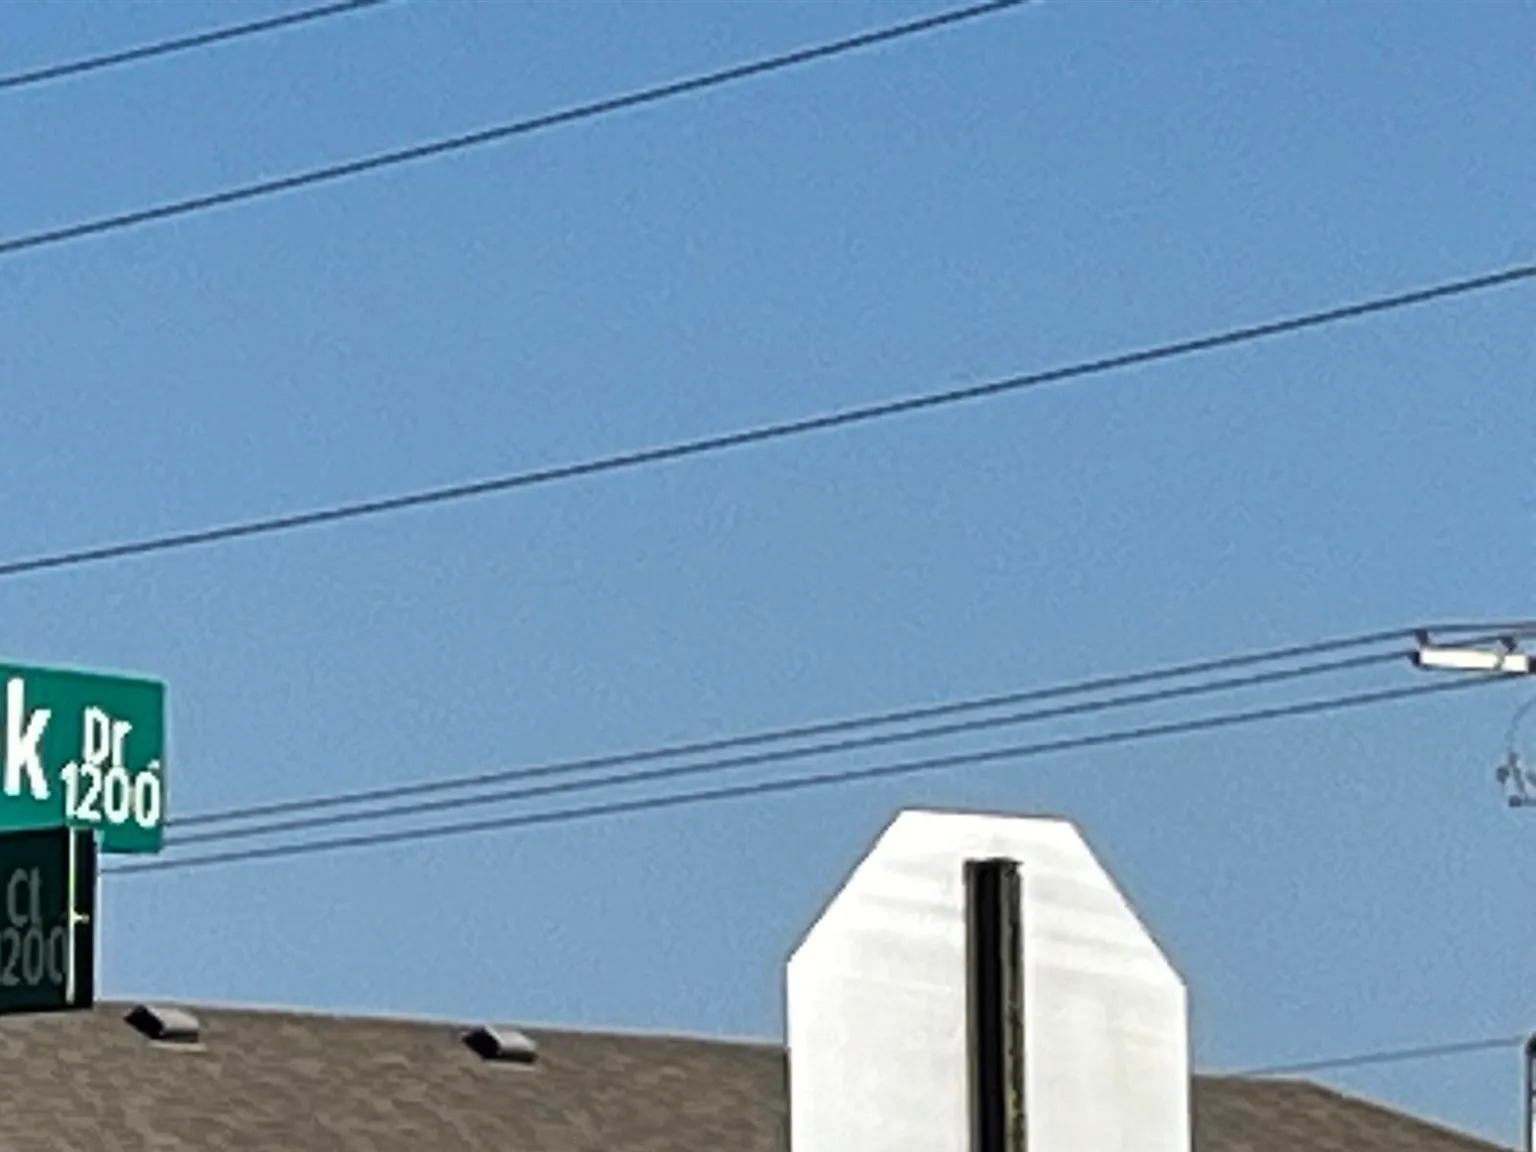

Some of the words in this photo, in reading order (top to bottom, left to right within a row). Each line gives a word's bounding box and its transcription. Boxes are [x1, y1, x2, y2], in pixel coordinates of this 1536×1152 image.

[83, 706, 133, 766] Dr
[61, 760, 161, 828] 1200
[6, 867, 42, 927] Ct
